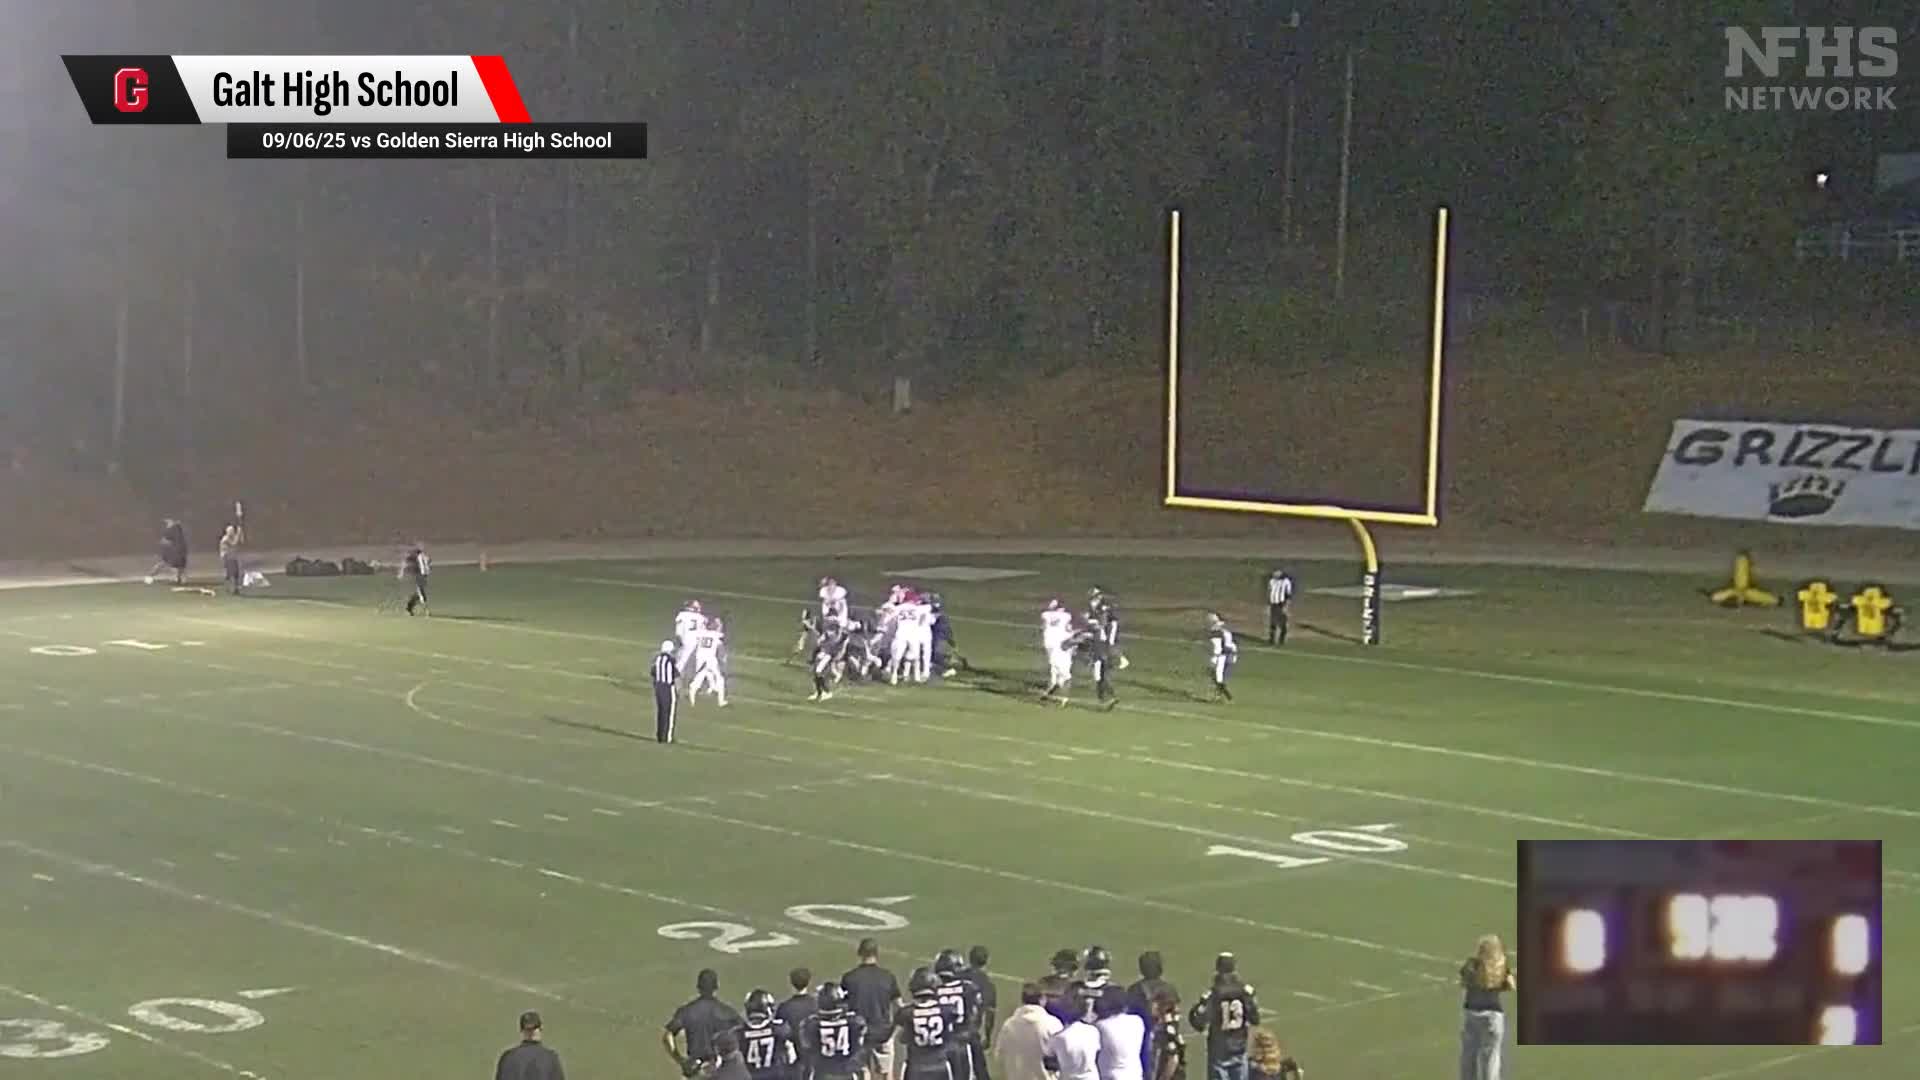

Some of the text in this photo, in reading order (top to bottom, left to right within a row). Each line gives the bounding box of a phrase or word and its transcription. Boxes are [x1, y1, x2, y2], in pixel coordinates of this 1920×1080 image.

[1205, 830, 1408, 868] 10
[657, 904, 909, 953] 20
[913, 1015, 943, 1046] 52
[1221, 1000, 1244, 1030] 13
[747, 1037, 775, 1068] 47
[820, 1026, 849, 1056] 54
